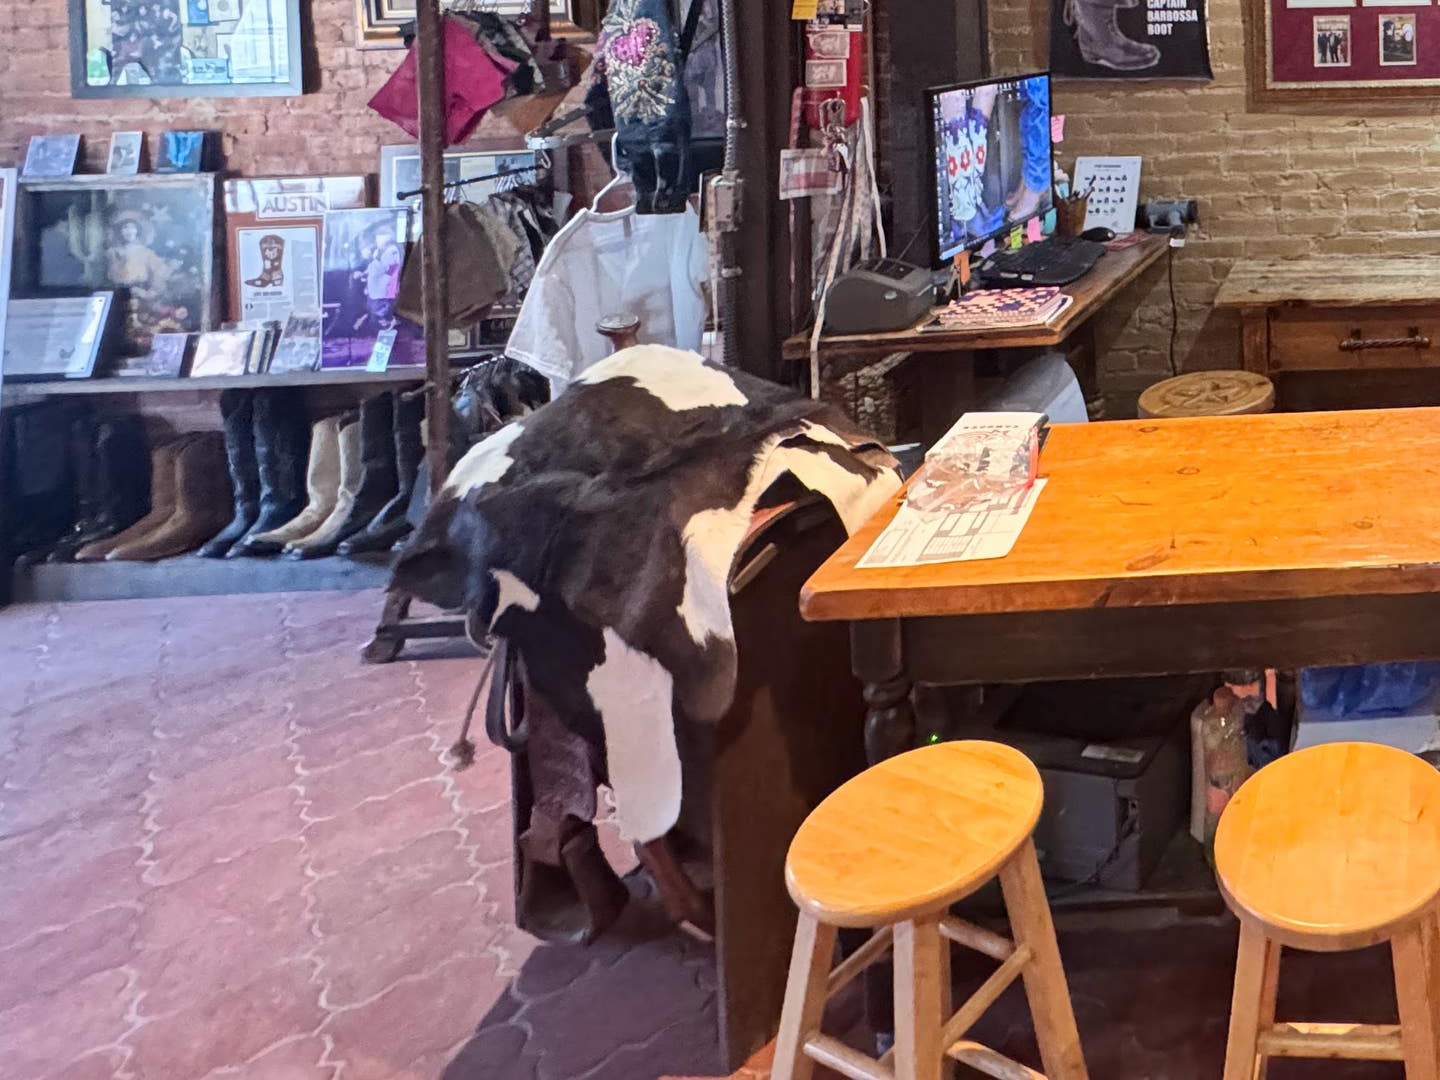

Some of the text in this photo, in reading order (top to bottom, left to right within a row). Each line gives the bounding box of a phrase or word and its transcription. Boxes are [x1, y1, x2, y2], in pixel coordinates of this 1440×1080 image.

[1147, 10, 1198, 22] BARBOSSA
[1147, 23, 1173, 35] BOOT
[262, 196, 327, 213] AUSTIN
